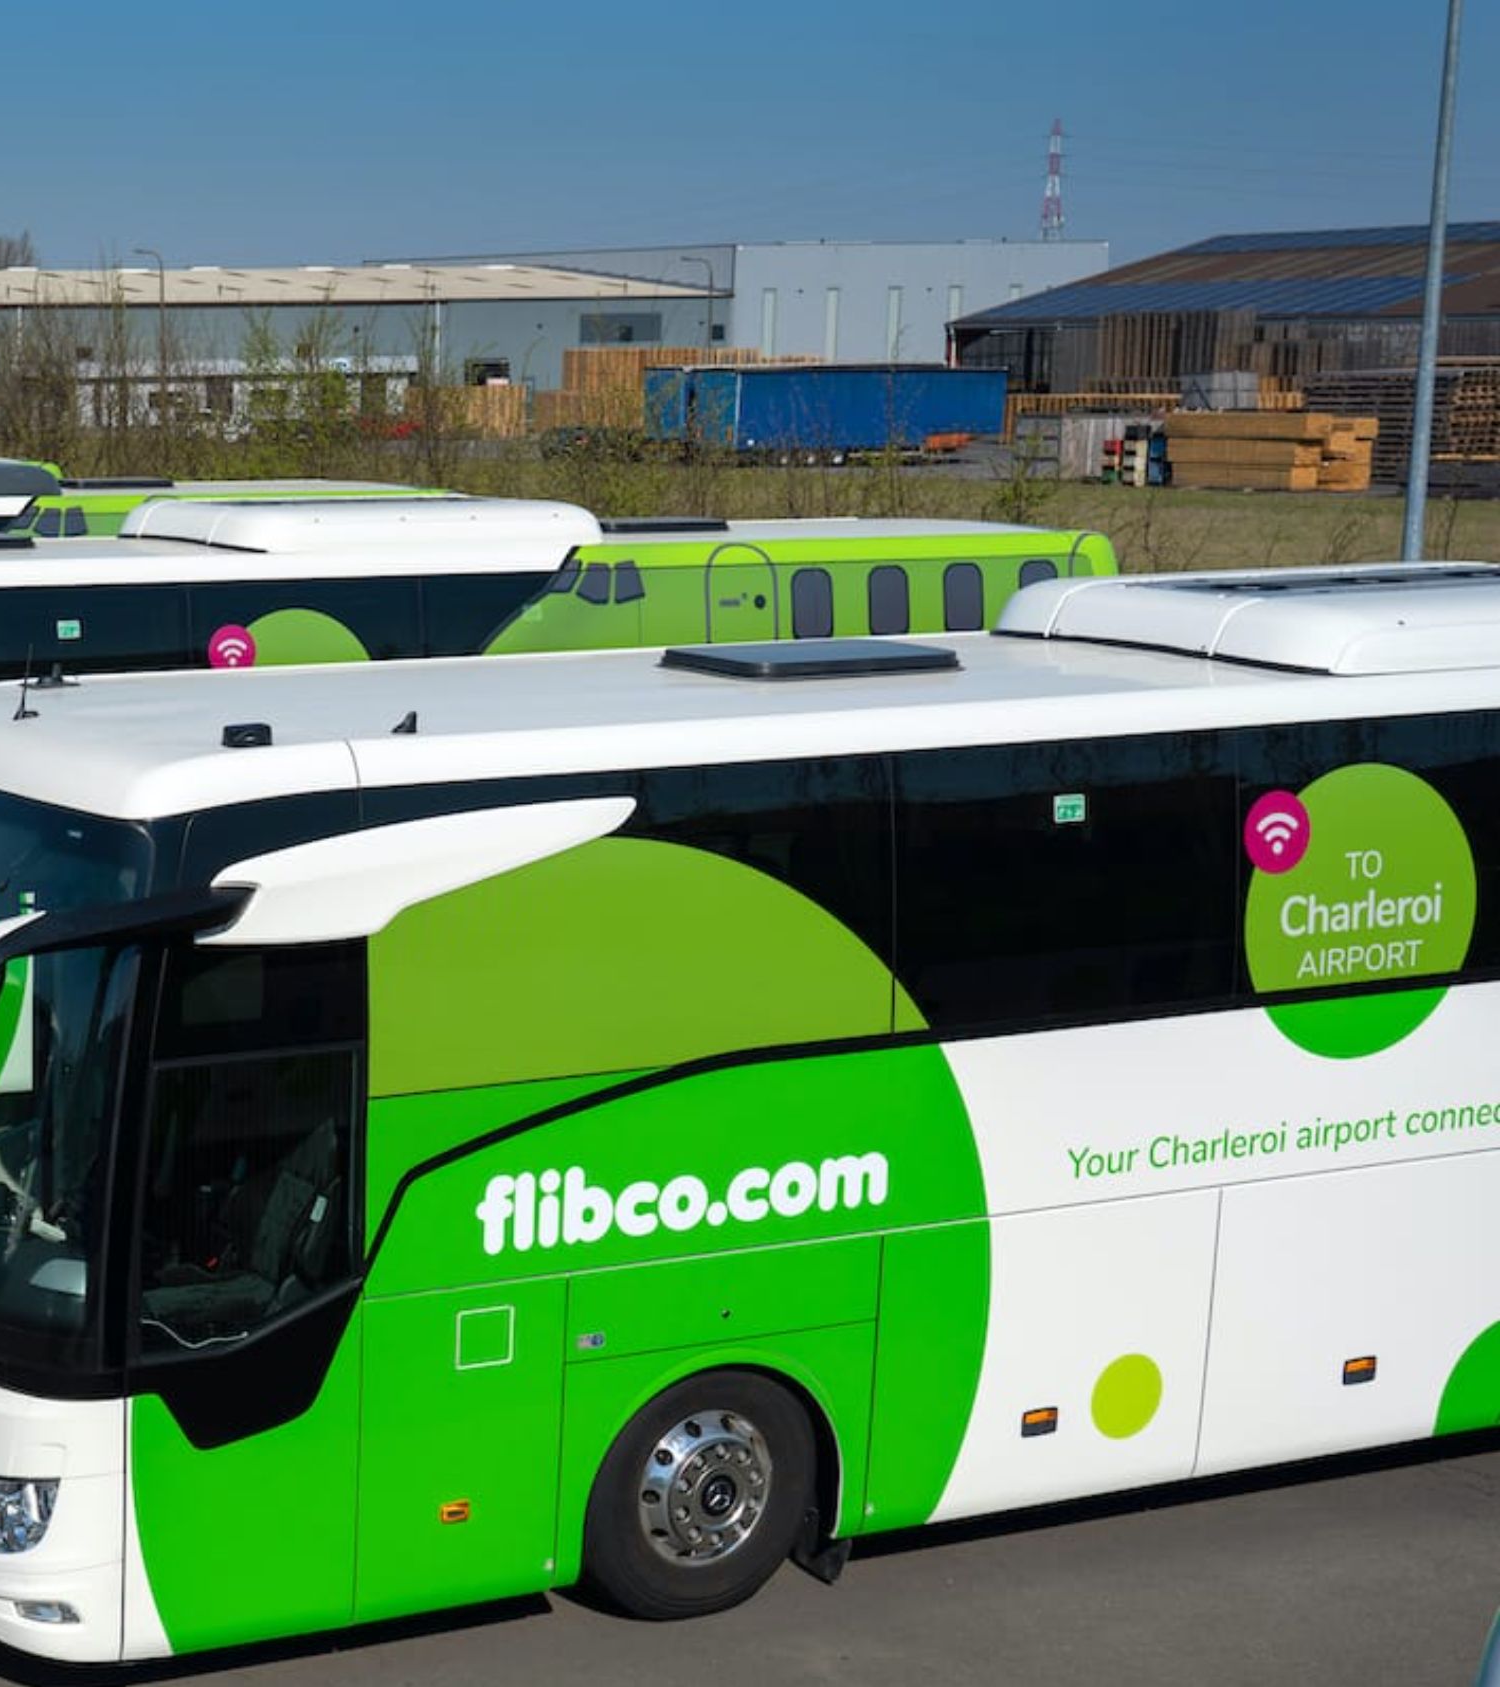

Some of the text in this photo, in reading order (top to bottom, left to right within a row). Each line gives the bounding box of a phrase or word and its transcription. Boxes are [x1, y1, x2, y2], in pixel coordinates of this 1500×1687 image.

[1345, 850, 1382, 880] TO
[1280, 881, 1443, 938] Charleroi
[1296, 939, 1424, 979] AIRPORT
[1067, 1146, 1140, 1180] Your
[1149, 1120, 1287, 1169] Charleroi
[1295, 1110, 1398, 1152] airport
[476, 1151, 889, 1256] flibco.com
